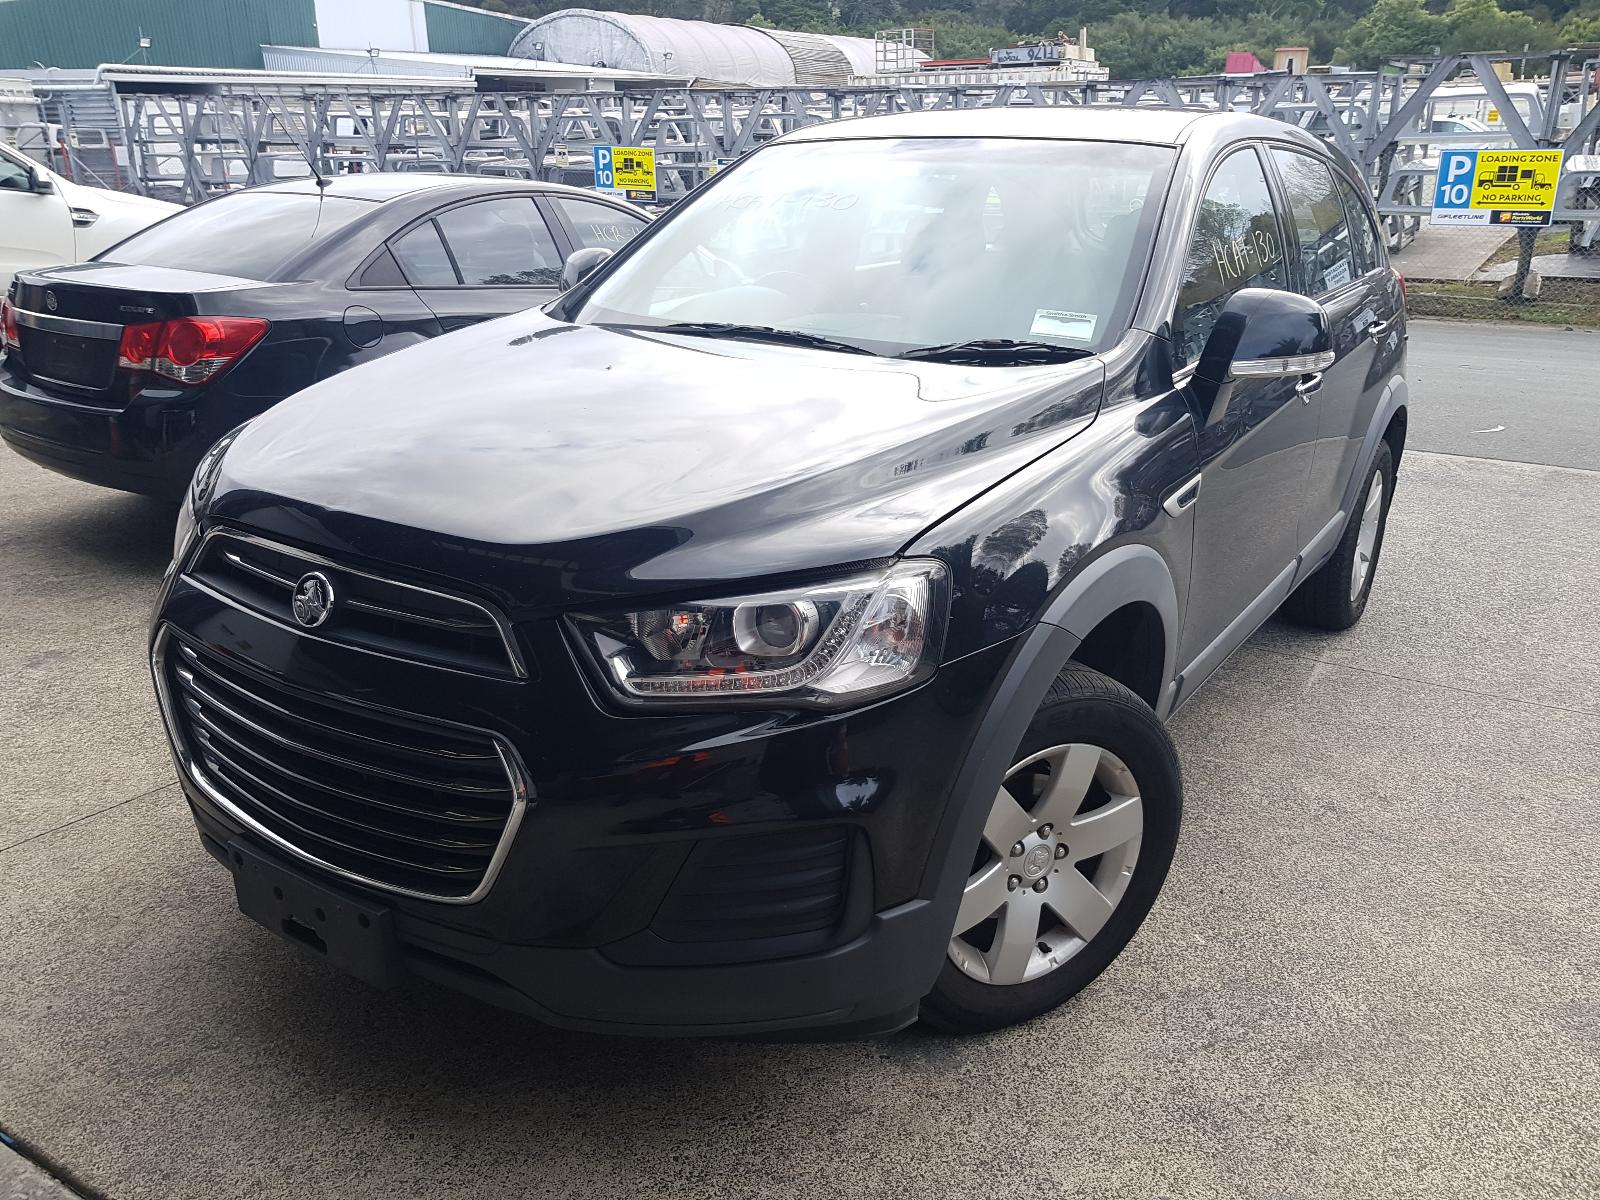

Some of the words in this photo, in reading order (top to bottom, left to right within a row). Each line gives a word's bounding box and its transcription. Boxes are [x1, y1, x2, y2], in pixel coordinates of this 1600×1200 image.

[598, 149, 611, 169] P
[1480, 155, 1527, 163] LOADING
[1529, 154, 1559, 163] ZONE
[597, 170, 613, 185] 10
[1447, 155, 1472, 183] P
[1440, 184, 1469, 205] 10
[1498, 194, 1542, 202] PARKING
